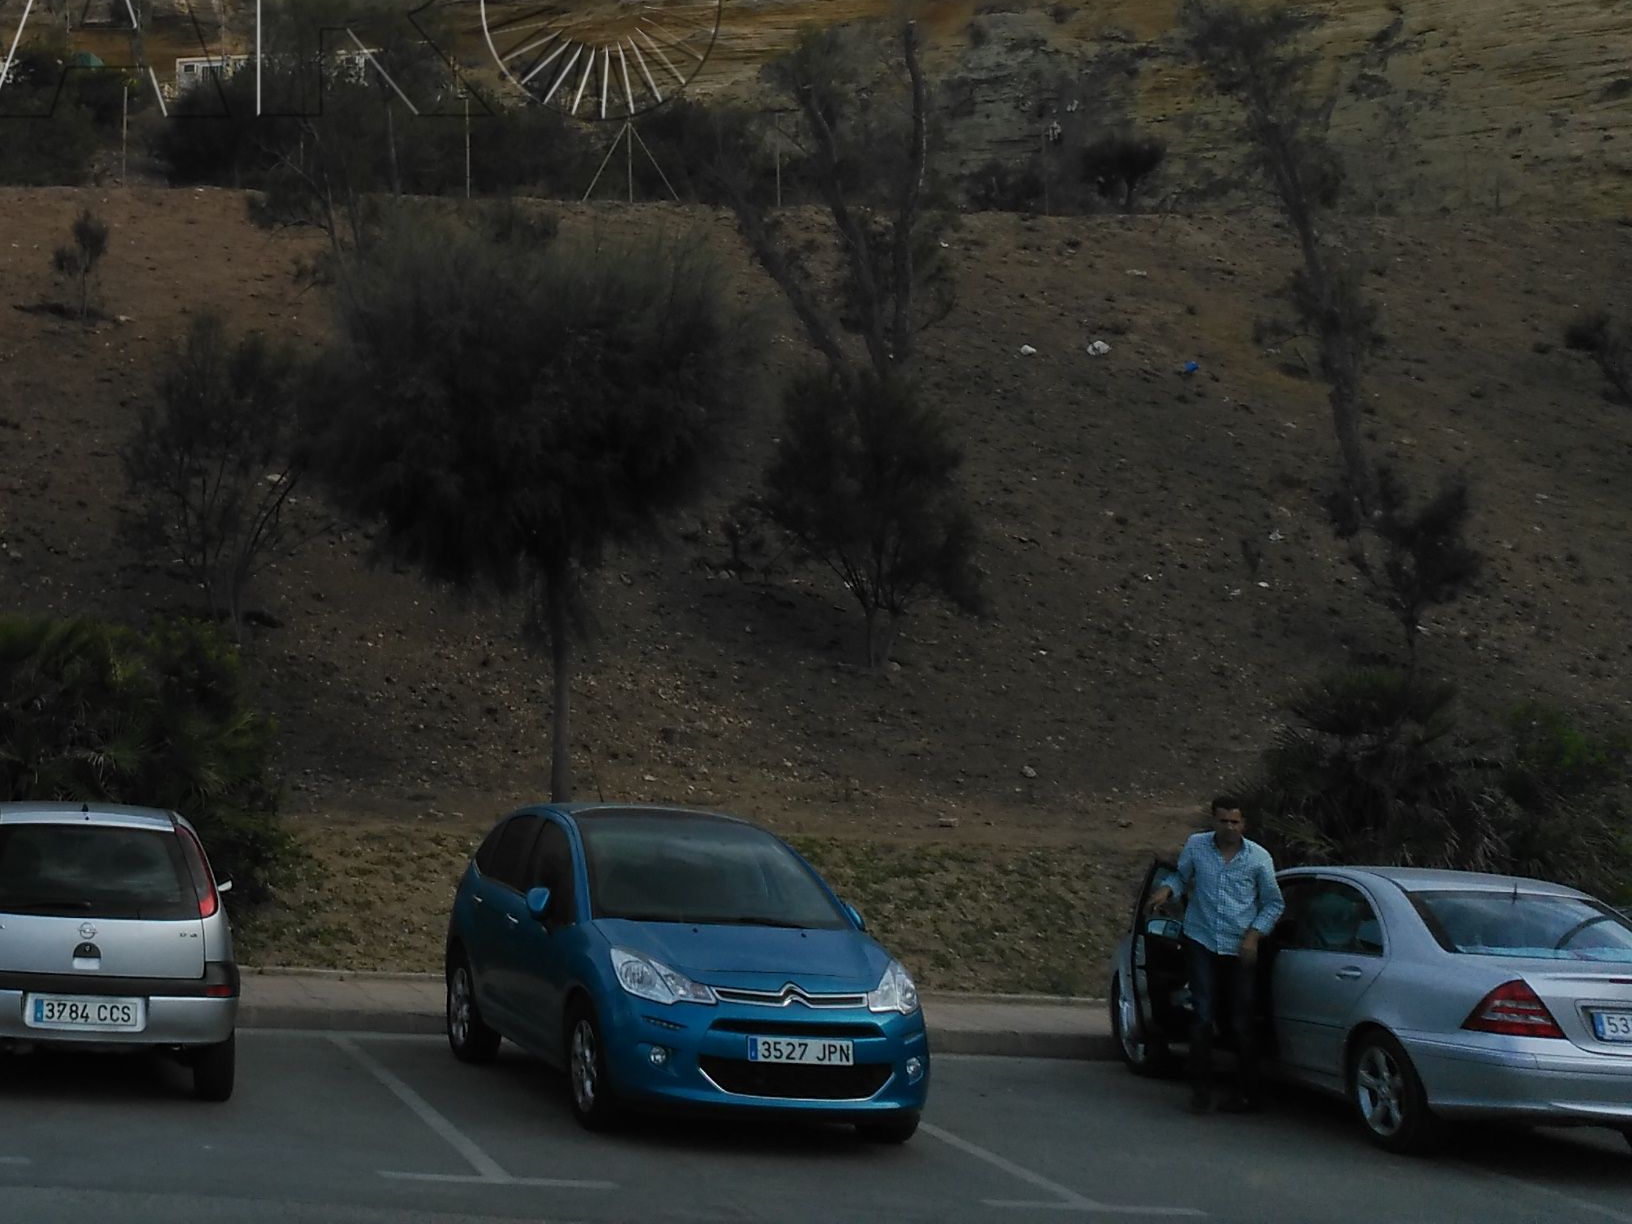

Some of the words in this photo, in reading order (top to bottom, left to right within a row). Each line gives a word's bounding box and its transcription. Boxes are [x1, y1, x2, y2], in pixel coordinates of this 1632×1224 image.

[45, 1002, 90, 1022] 3784
[97, 1004, 131, 1022] CCS
[761, 1041, 809, 1060] 3527
[816, 1043, 850, 1062] JPN
